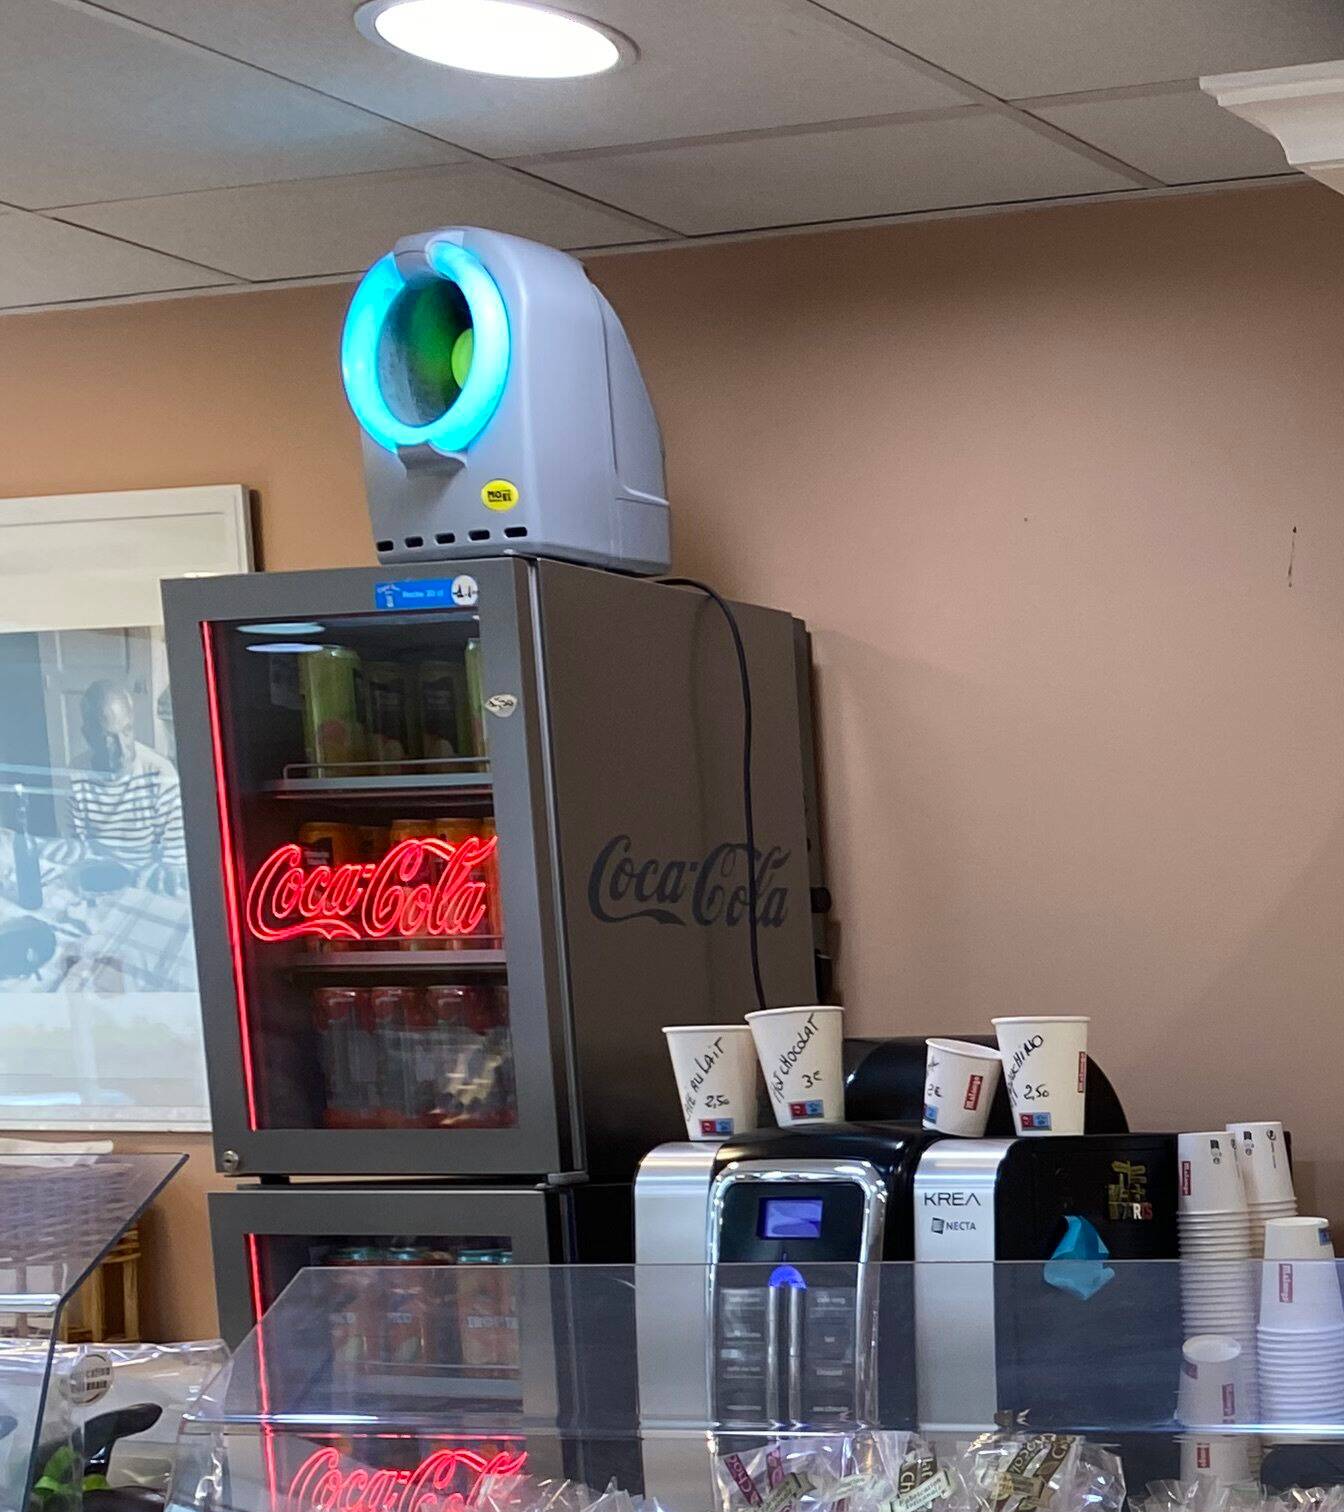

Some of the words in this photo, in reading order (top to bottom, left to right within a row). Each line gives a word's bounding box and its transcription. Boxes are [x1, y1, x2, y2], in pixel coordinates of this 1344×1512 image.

[248, 835, 498, 942] Coca-Cola
[588, 834, 791, 928] Coca-Cola
[924, 1192, 981, 1206] KREA
[946, 1221, 977, 1231] NECTA
